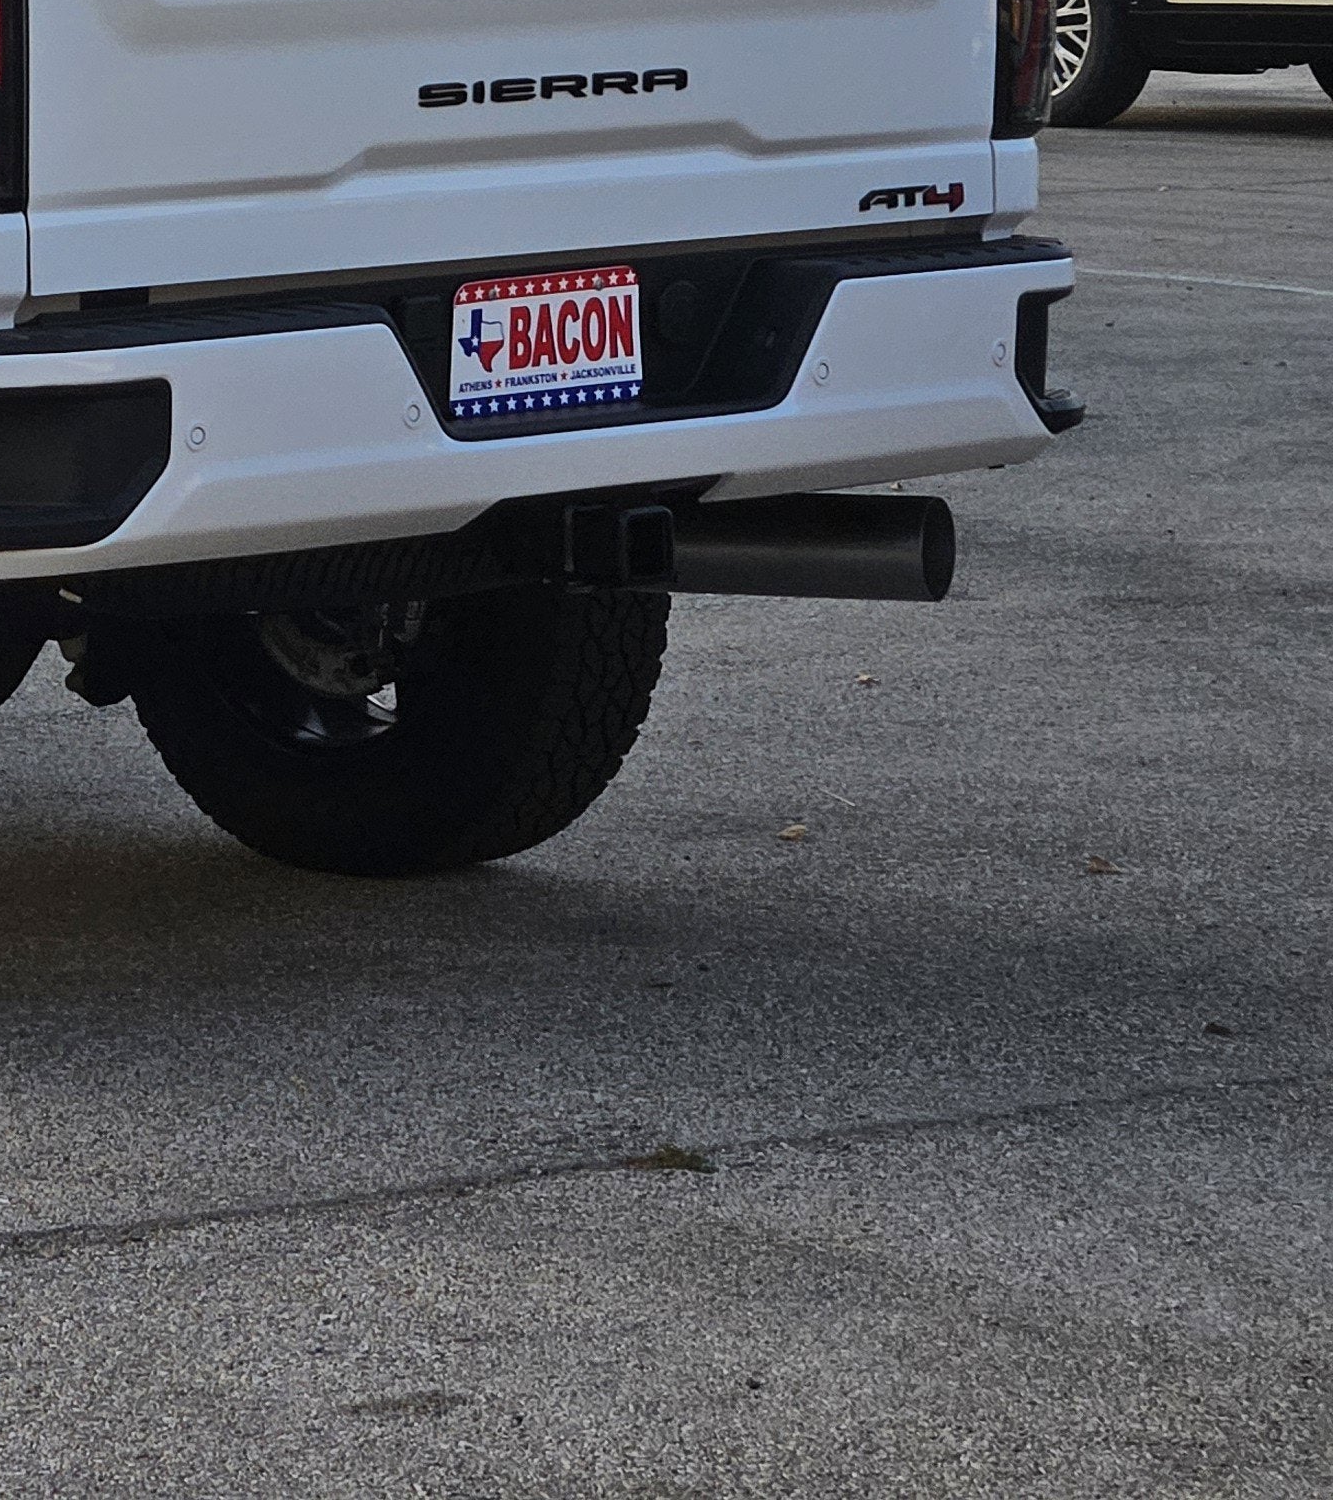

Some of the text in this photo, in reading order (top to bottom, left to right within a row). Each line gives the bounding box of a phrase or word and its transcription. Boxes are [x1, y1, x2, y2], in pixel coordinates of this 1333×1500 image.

[418, 68, 688, 108] SIERRA
[858, 182, 965, 213] AT4
[508, 294, 635, 371] BACON
[458, 363, 637, 394] ATHENS FRANKSTON JACKSONVILLE
